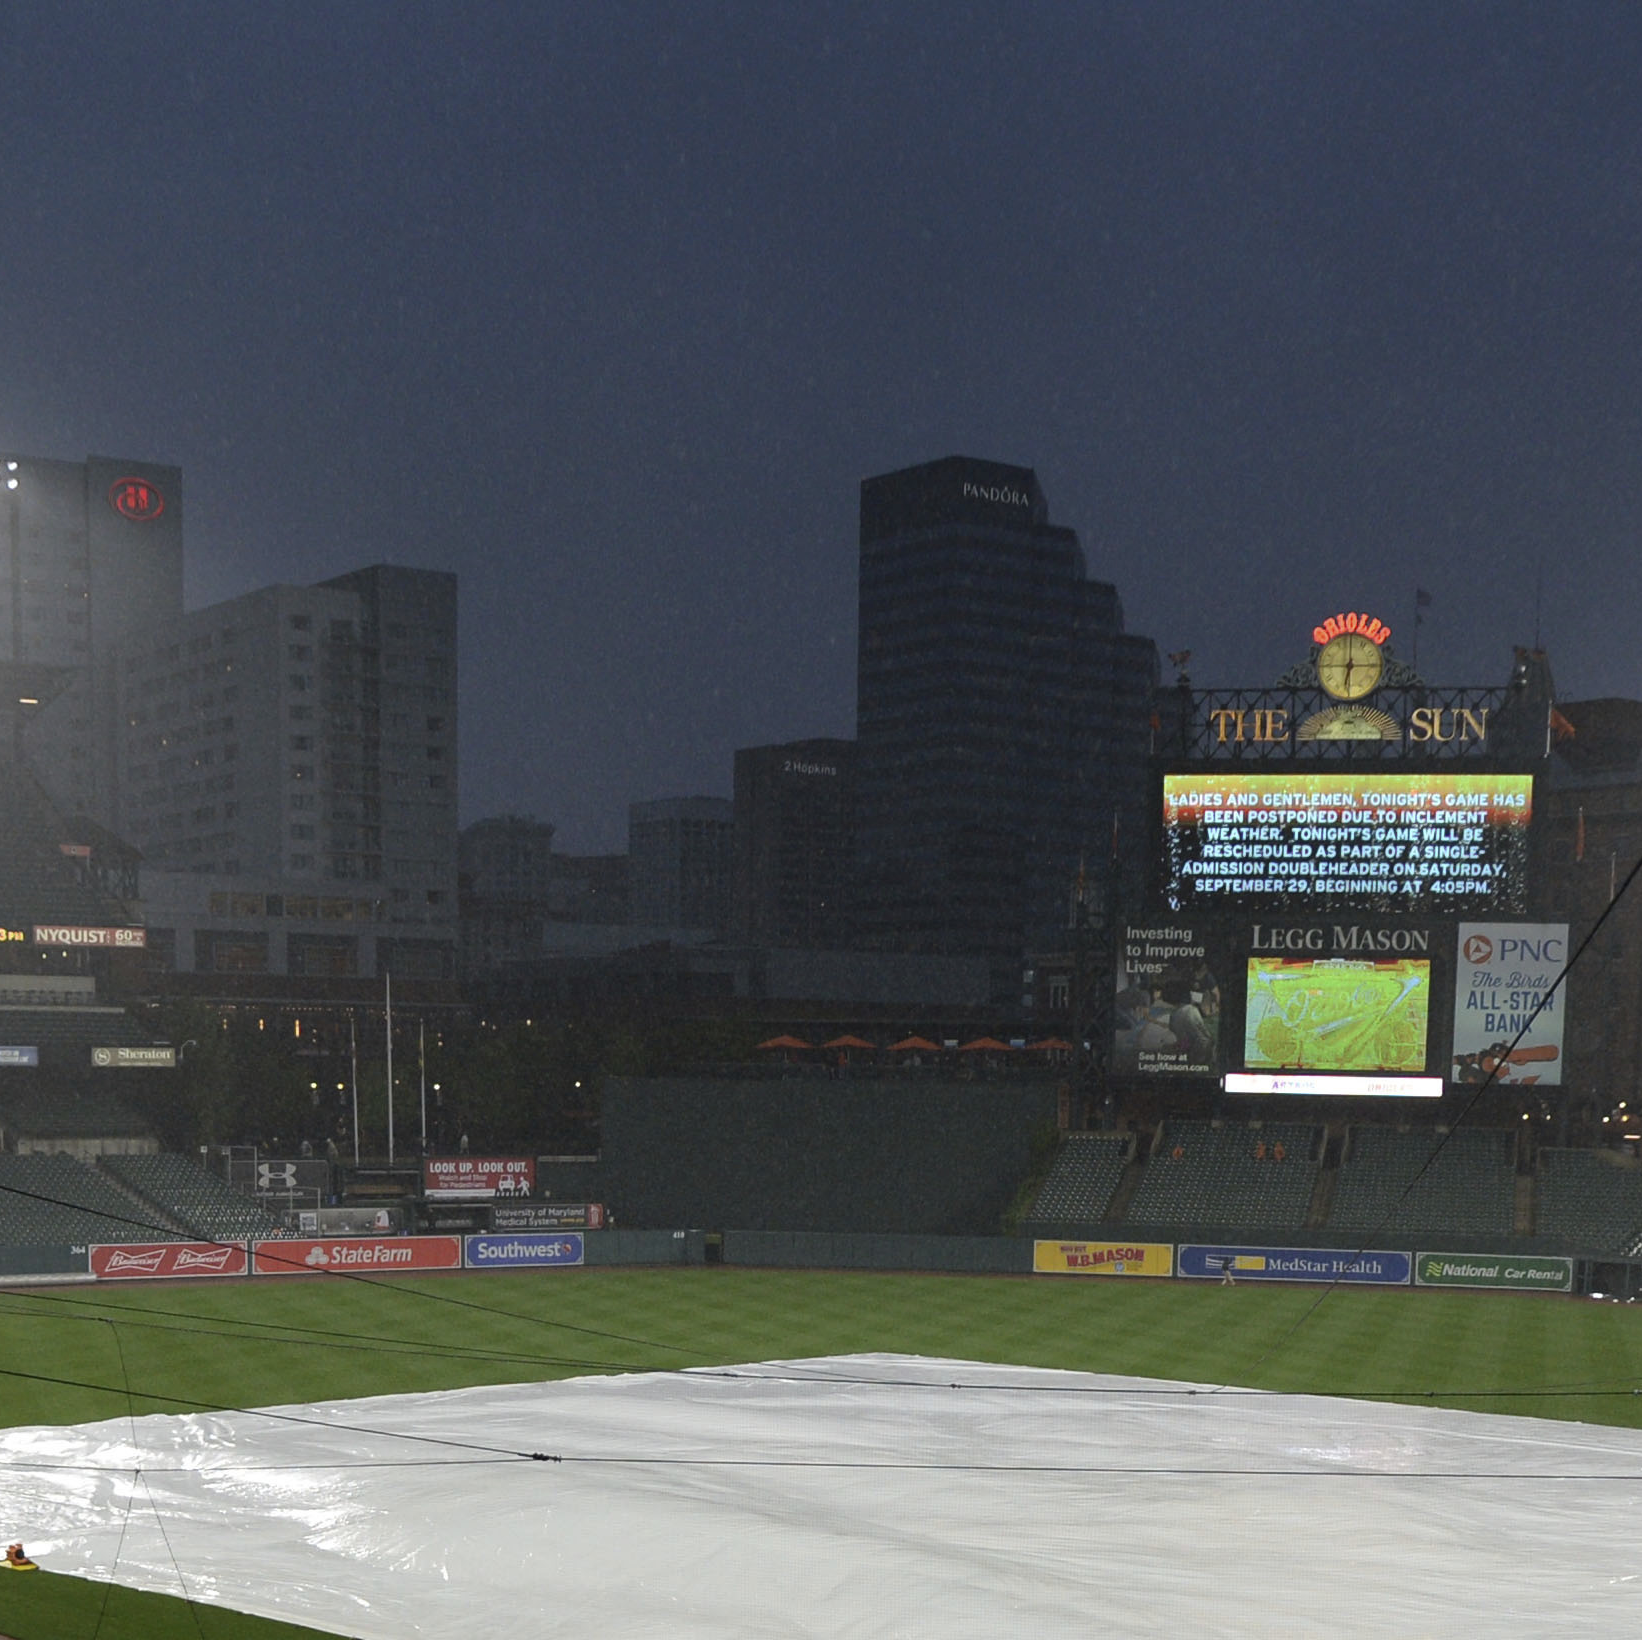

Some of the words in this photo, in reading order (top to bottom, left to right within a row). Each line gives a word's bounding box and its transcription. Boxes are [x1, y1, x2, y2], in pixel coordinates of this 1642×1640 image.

[1312, 612, 1392, 645] ORIOLES
[1210, 709, 1289, 742] THE
[1410, 708, 1489, 742] SUN
[793, 762, 837, 777] Hopkins
[1168, 793, 1223, 806] LADIES
[1226, 793, 1258, 806] AND
[1262, 793, 1357, 807] GENTLEMEN,
[1361, 793, 1441, 806] TONIGHT'S
[1445, 793, 1489, 806] GAME
[1493, 793, 1526, 806] HAS
[1203, 810, 1244, 823] BEEN
[1247, 810, 1338, 823] POSTPONED
[1341, 810, 1373, 823] DUE
[1377, 811, 1397, 824] TO
[1400, 811, 1488, 824] INCLEMENT
[1207, 827, 1284, 841] WEATHER.
[1291, 827, 1371, 841] TONIGHT'S
[1375, 828, 1419, 841] GAME
[1422, 828, 1459, 842] WILL
[1463, 828, 1484, 842] BE
[1203, 845, 1312, 858] RESCHEDULED
[1315, 845, 1337, 858] AS
[1340, 845, 1381, 858] PART
[1385, 845, 1406, 858] OF
[1408, 846, 1420, 859] A
[1424, 846, 1486, 859] SINGLE-
[1181, 862, 1265, 875] ADMISSION
[1268, 862, 1390, 876] DOUBLEHEADER
[1393, 863, 1415, 876] ON
[1419, 863, 1507, 878] SATURDAY,
[1195, 879, 1284, 892] SEPTEMBER
[1287, 879, 1311, 894] 29,
[1315, 880, 1398, 893] BEGINNING
[1401, 881, 1423, 894] AT
[1429, 881, 1492, 894] 4:05PM.
[9, 932, 24, 942] PM
[36, 927, 108, 945] NYQUIST
[114, 929, 133, 941] 60
[1126, 926, 1193, 943] Investing
[1251, 924, 1324, 950] LEGG
[1332, 925, 1430, 951] MASON
[1126, 944, 1143, 958] to
[1145, 943, 1205, 959] Improve
[1498, 938, 1563, 962] PNC
[1471, 971, 1503, 988] The
[1504, 971, 1551, 989] Birds
[1466, 990, 1555, 1011] ALL-STAR
[1484, 1012, 1533, 1034] BANK
[117, 1048, 171, 1060] Sheraton
[1138, 1051, 1156, 1062] See
[1157, 1052, 1177, 1062] how
[1178, 1053, 1188, 1062] at
[1138, 1062, 1209, 1073] LeggMason.com
[429, 1162, 456, 1174] LOOK
[459, 1162, 475, 1174] UP.
[478, 1162, 504, 1174] LOOK
[507, 1161, 529, 1174] OUT.
[495, 1207, 535, 1218] University
[538, 1207, 546, 1216] of
[548, 1207, 586, 1218] Maryland
[495, 1217, 528, 1226] Medical
[529, 1218, 558, 1228] System
[70, 1245, 86, 1255] 364
[477, 1241, 561, 1259] Southwest
[1268, 1257, 1329, 1272] MedStar
[1331, 1260, 1383, 1275] Health
[1442, 1263, 1498, 1278] National
[1504, 1268, 1526, 1279] Car
[1527, 1268, 1563, 1281] Rental
